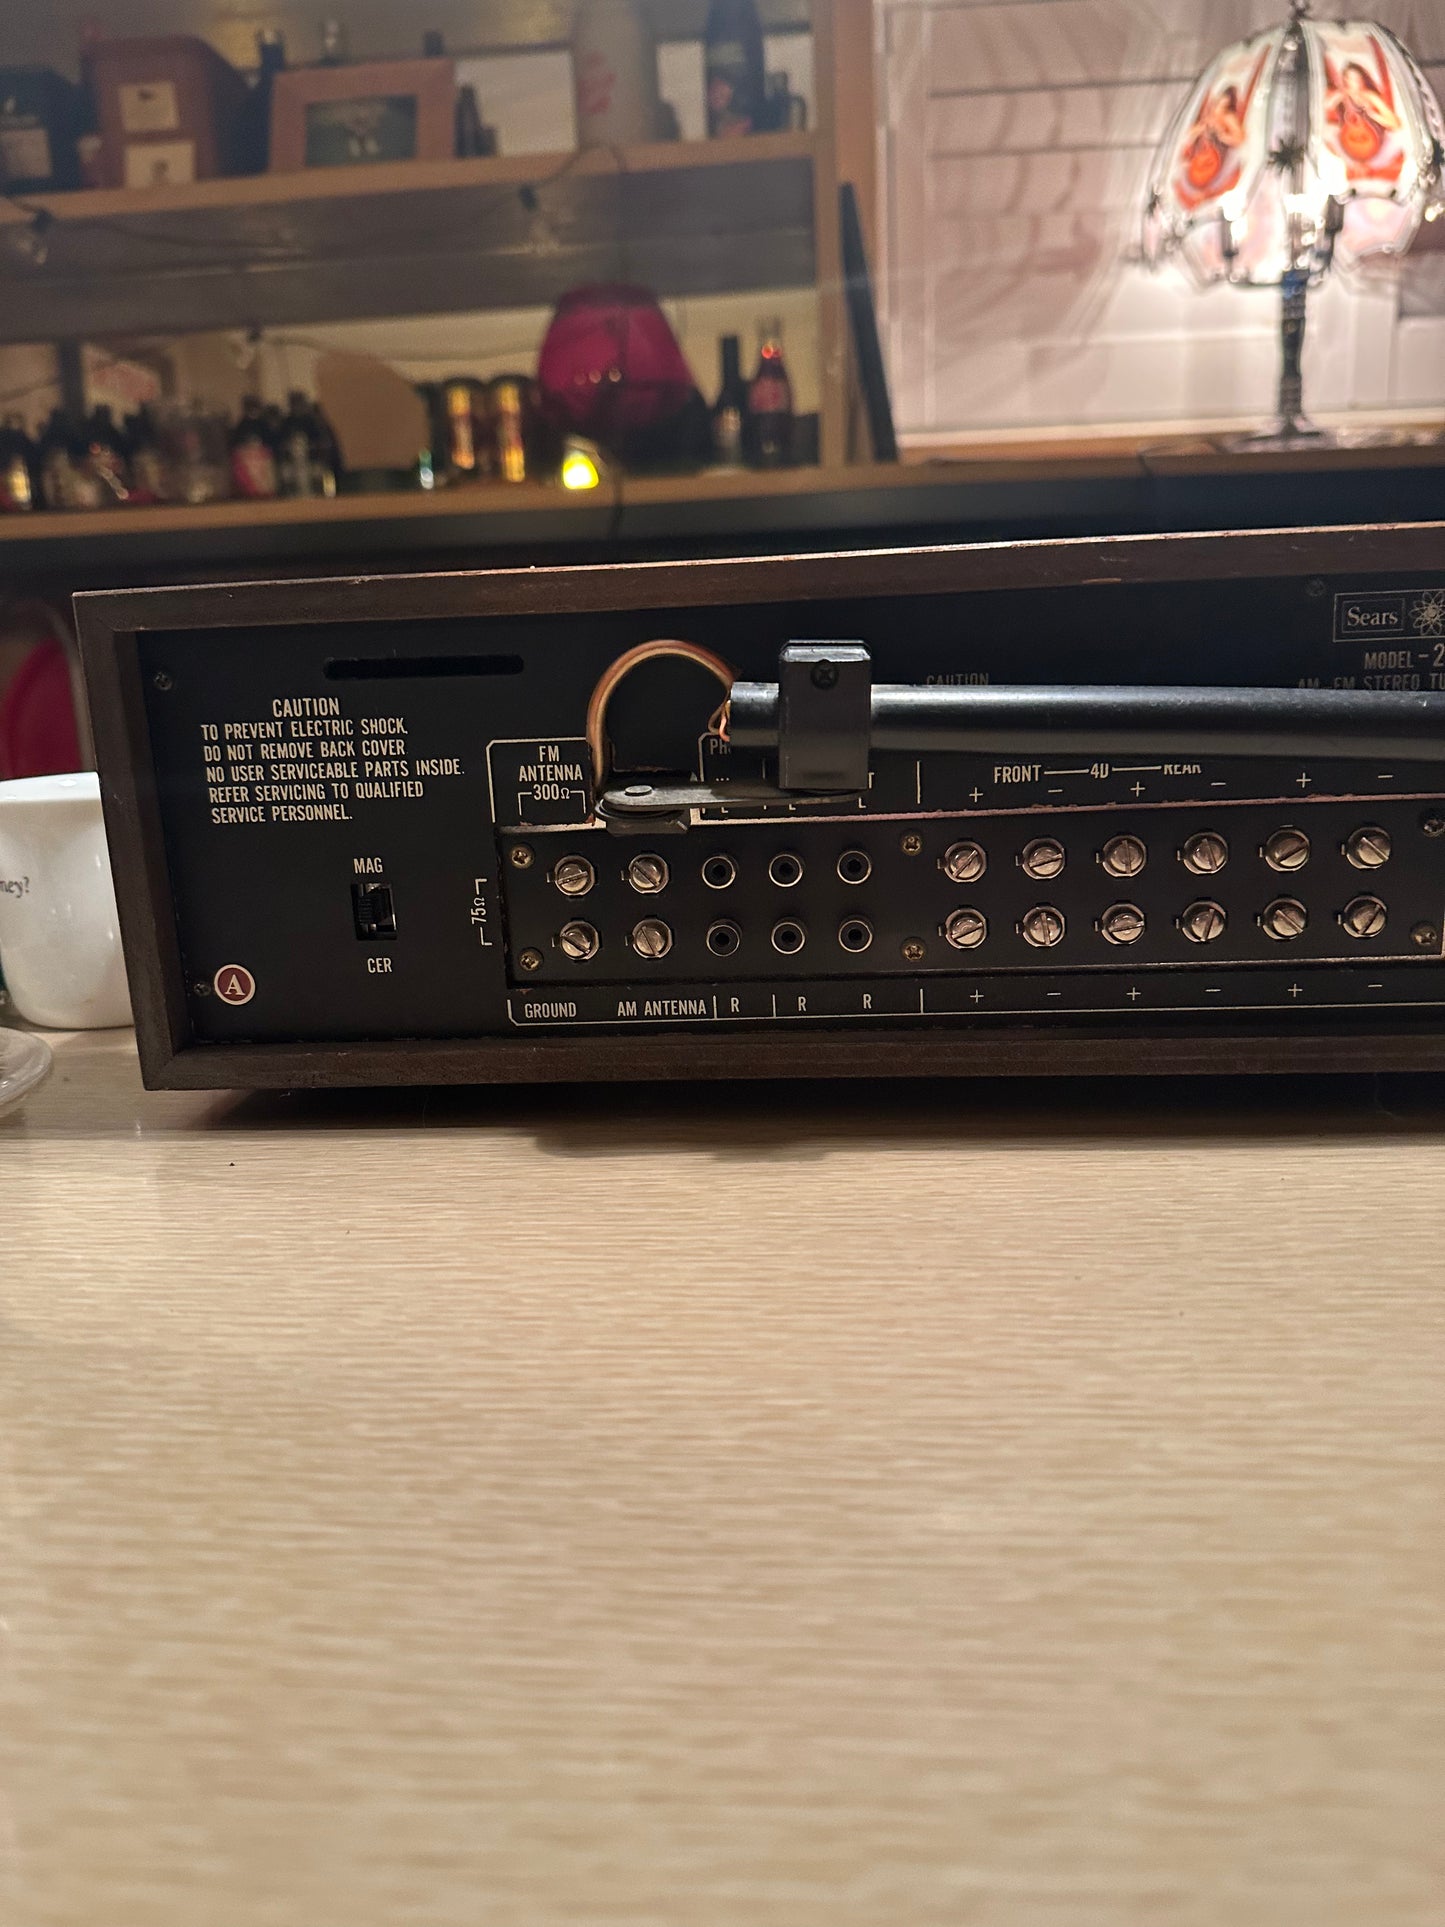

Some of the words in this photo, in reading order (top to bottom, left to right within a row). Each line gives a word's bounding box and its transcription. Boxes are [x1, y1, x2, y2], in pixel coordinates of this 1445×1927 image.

[1347, 606, 1399, 626] Sears
[272, 697, 340, 718] CAUTION
[200, 724, 219, 741] TO
[224, 721, 284, 740] PREVENT
[290, 719, 354, 738] ELECTRIC
[203, 744, 222, 762] DO
[226, 743, 253, 761] NOT
[260, 741, 314, 760] REMOVE
[320, 740, 356, 758] BACK
[538, 745, 560, 763] FM
[206, 766, 225, 783] NO
[230, 764, 265, 782] USER
[270, 761, 359, 781] SERVICEABLE
[364, 760, 409, 778] PARTS
[415, 758, 465, 776] INSIDE.
[518, 763, 584, 782] ANTENNA
[994, 764, 1042, 784] FRONT
[208, 785, 250, 804] REFER
[254, 783, 326, 802] SERVICING
[330, 782, 349, 799] TO
[355, 780, 424, 799] QUALIFIED
[211, 805, 266, 824] SERVICE
[271, 803, 353, 822] PERSONNEL.
[353, 857, 383, 874] MAG
[367, 957, 393, 974] CER
[225, 973, 247, 996] A
[524, 1001, 577, 1019] GROUND
[617, 1000, 638, 1017] AM
[644, 999, 707, 1016] ANTENNA
[730, 997, 740, 1013] R
[797, 996, 807, 1012] R
[862, 993, 872, 1009] R
